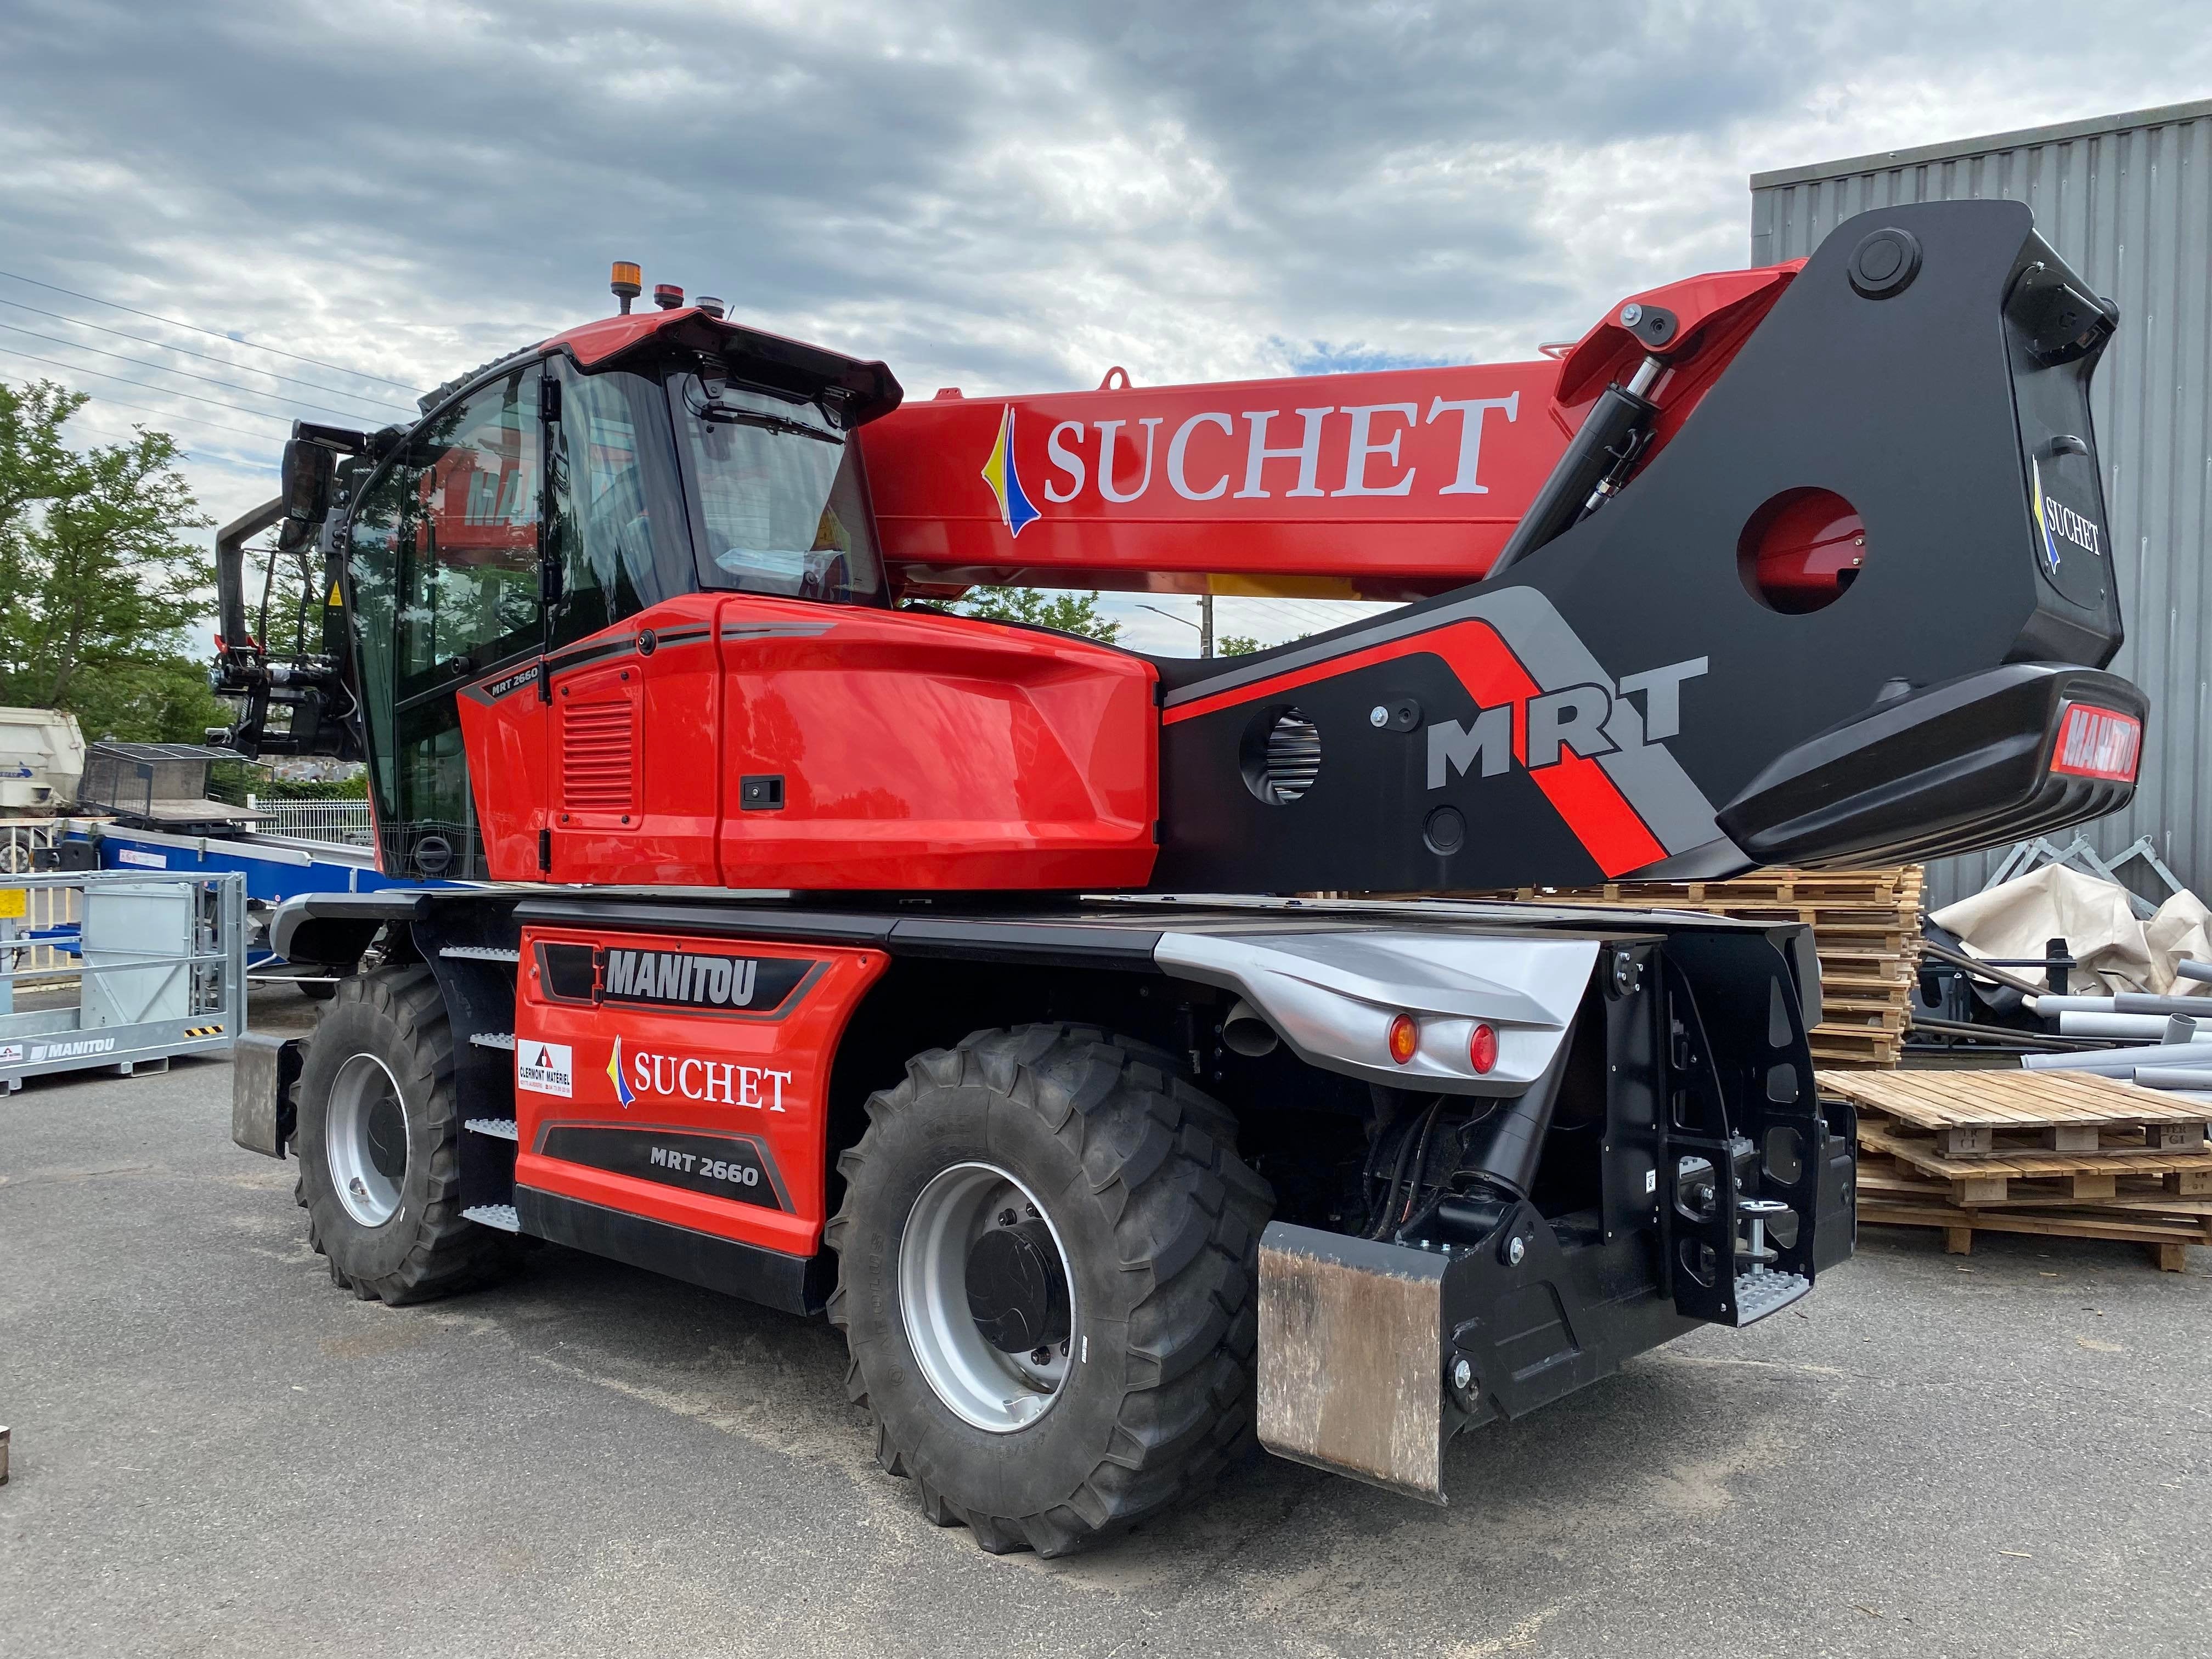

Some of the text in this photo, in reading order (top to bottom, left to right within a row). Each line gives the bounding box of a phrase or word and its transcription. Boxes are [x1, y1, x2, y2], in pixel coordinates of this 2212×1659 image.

[1044, 390, 1520, 503] SUCHET
[2046, 496, 2100, 556] SUCHET
[492, 668, 538, 696] MRT 2660
[1427, 655, 1708, 791] MRT
[2061, 709, 2140, 775] MANITOU
[606, 950, 758, 1006] MANITOU
[48, 1038, 115, 1058] MANITOU
[520, 1066, 544, 1081] CLERMONT
[634, 1051, 792, 1113] SUCHET
[650, 1146, 759, 1187] MRT 2660
